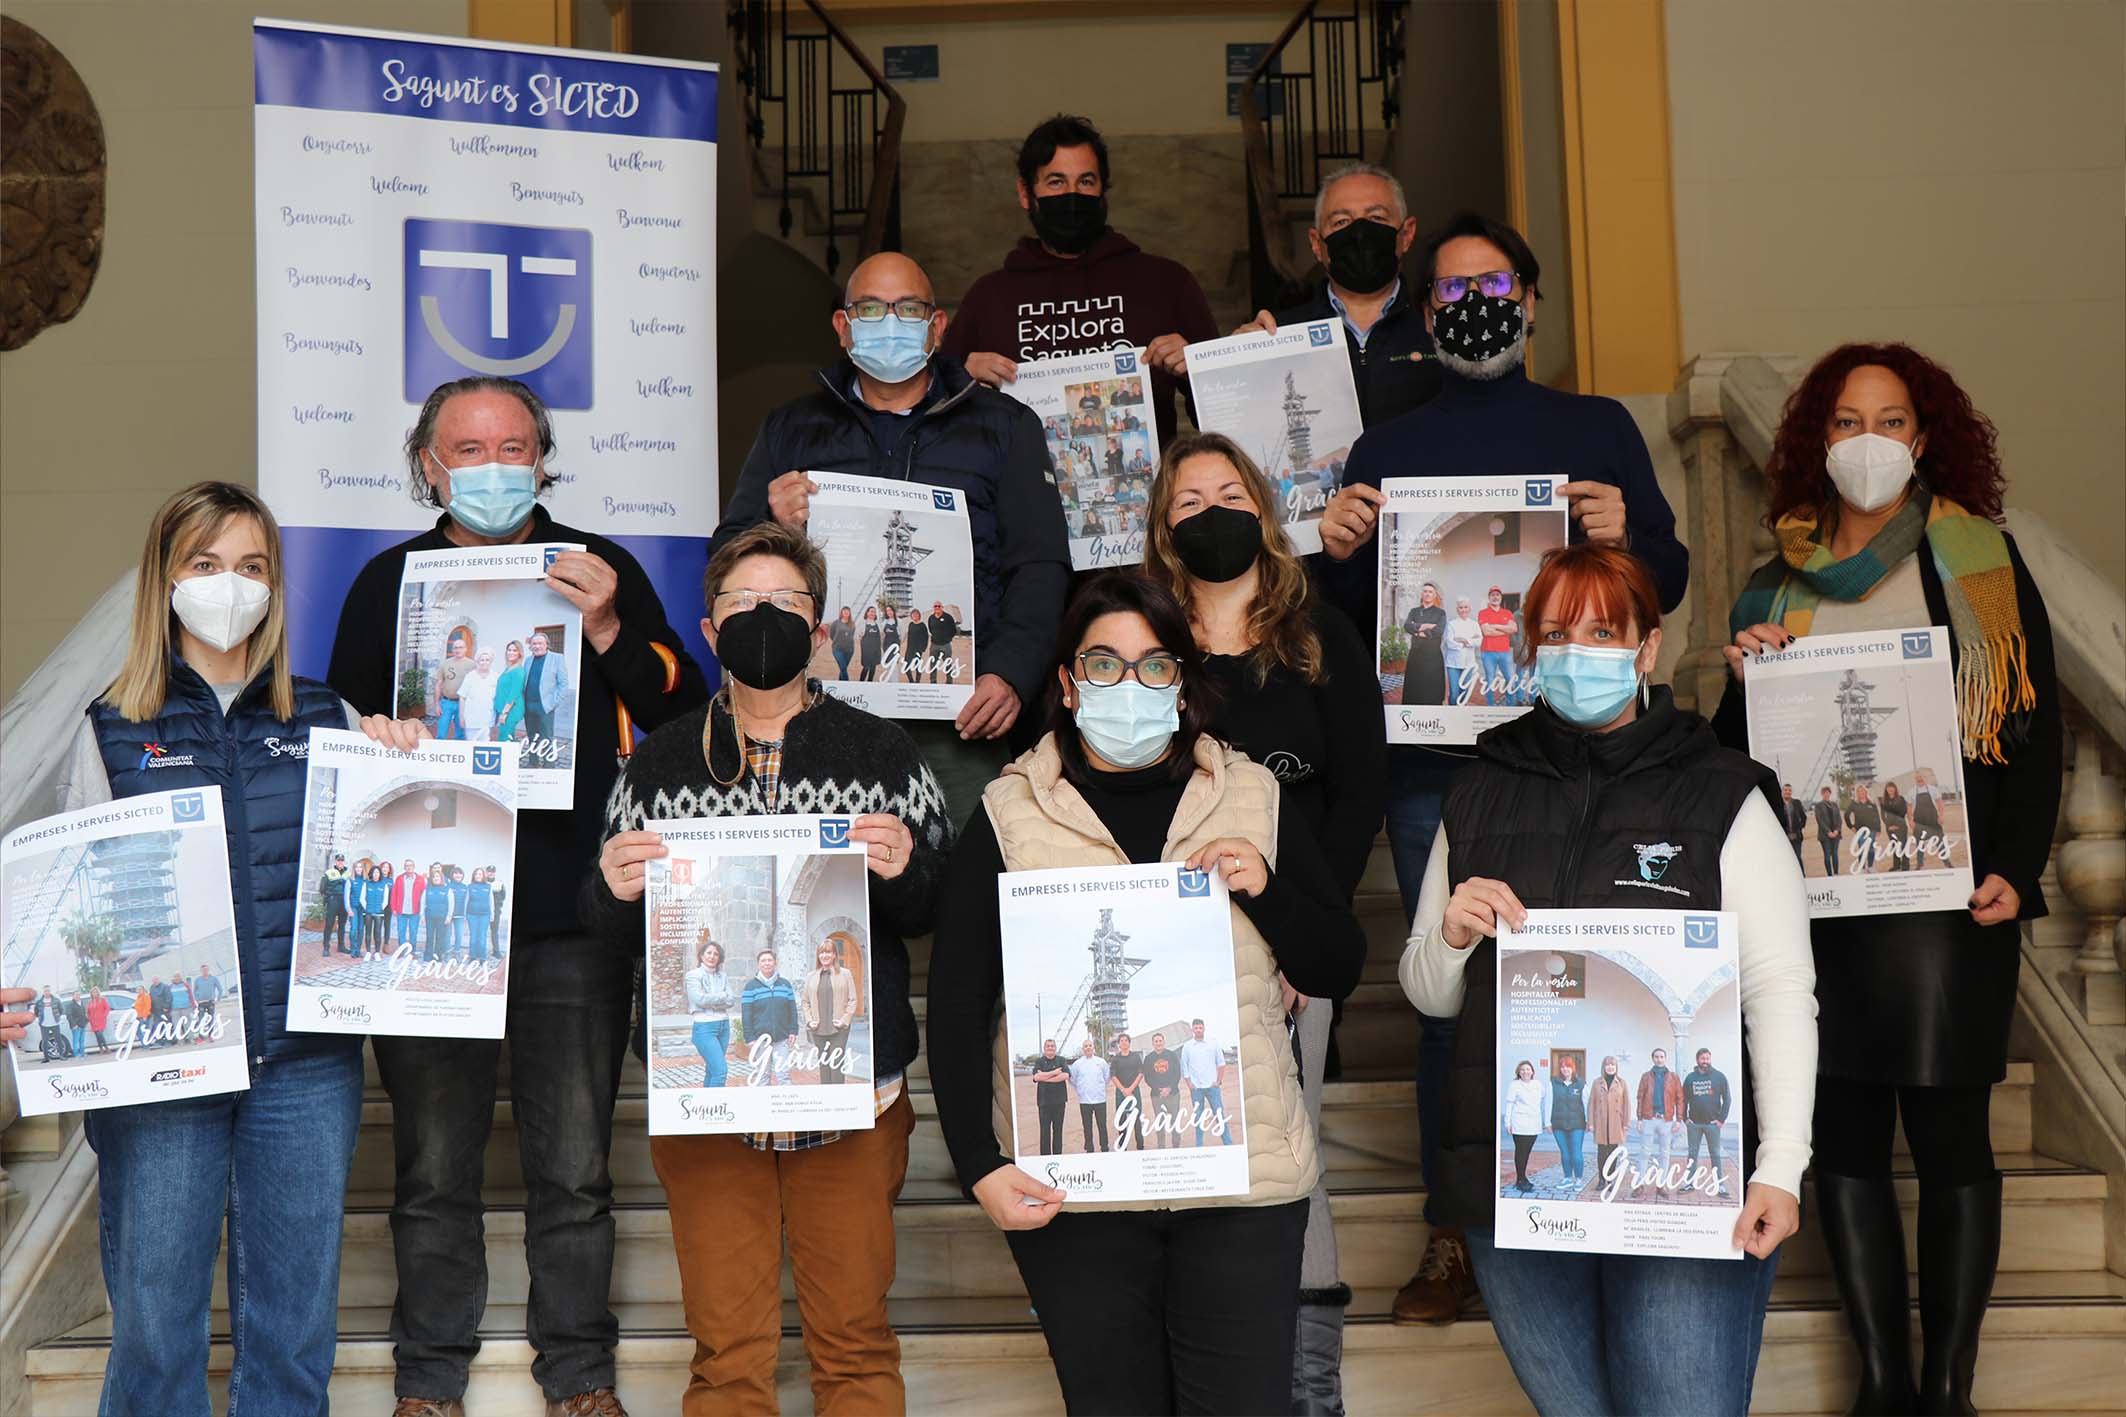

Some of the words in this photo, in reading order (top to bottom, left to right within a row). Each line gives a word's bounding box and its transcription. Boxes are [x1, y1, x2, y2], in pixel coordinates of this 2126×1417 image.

[382, 59, 489, 108] Sagunt
[490, 83, 519, 112] es
[528, 73, 640, 119] SICTED
[448, 135, 538, 159] Willkommen
[607, 151, 665, 172] Welkom
[370, 175, 430, 195] Welcome
[511, 181, 584, 206] Benvinguts
[280, 206, 353, 226] Benvenuti
[616, 208, 682, 229] Bienvenue
[286, 267, 372, 290] Bienvenidos
[630, 318, 686, 336] Welcome
[1018, 316, 1125, 346] Explora
[284, 332, 363, 356] Benvinguts
[1194, 346, 1237, 361] EMPRESES
[1243, 340, 1275, 352] SERVEIS
[1275, 334, 1304, 346] SICTED
[1015, 370, 1046, 381] PRESES
[1052, 365, 1082, 377] SERVEIS
[1083, 361, 1110, 371] SICTED
[636, 379, 694, 399] Welkom
[292, 404, 354, 424] Welcome
[589, 433, 676, 453] Willkommen
[319, 468, 401, 491] Bienvenidos
[867, 487, 900, 498] SERVEIS
[901, 491, 929, 501] SICTED
[1287, 484, 1339, 524] Gràc
[1390, 489, 1438, 499] EMPRESES
[1445, 488, 1483, 498] SERVEIS
[1485, 488, 1519, 497] SICTED
[603, 495, 676, 517] Benvinguts
[1090, 528, 1145, 567] Gràcie
[414, 559, 460, 570] EMPRESES
[467, 557, 504, 567] SERVEIS
[505, 556, 538, 565] SICTED
[879, 643, 967, 684] Gràcies
[1754, 650, 1806, 665] EMPRESES
[1813, 646, 1855, 657] SERVEIS
[1857, 642, 1895, 654] SICTED
[1456, 663, 1542, 706] Gràcie
[149, 755, 193, 763] COMUNITAT
[267, 740, 309, 757] Sagu
[321, 742, 377, 758] EMPRESES
[384, 750, 427, 762] SERVEIS
[429, 752, 466, 764] SICTED
[508, 733, 566, 762] cies
[148, 761, 194, 769] VALENCIANA
[12, 825, 68, 848] EMPRESES
[77, 812, 122, 830] SERVEIS
[123, 805, 164, 821] SICTED
[659, 830, 716, 841] EMPRESES
[725, 829, 770, 840] SERVEIS
[773, 828, 812, 839] SICTED
[1850, 826, 1960, 874] Gràcies
[1011, 883, 1070, 897] EMPRESES
[1079, 881, 1126, 893] SERVEIS
[1129, 878, 1170, 890] SICTED
[1582, 924, 1629, 935] SERVEIS
[1632, 925, 1676, 936] SICTED
[386, 942, 498, 991] Gràcies
[1511, 973, 1528, 987] Per
[1530, 972, 1544, 988] la
[1545, 973, 1578, 988] vostra
[320, 998, 371, 1023] Sagunt
[115, 1007, 232, 1062] Gràcies
[747, 1033, 862, 1087] Gràcies
[156, 1071, 179, 1081] RADIO
[181, 1065, 207, 1078] taxi
[51, 1078, 109, 1098] Sagunt
[681, 1098, 735, 1121] Sagunt
[1113, 1095, 1233, 1152] Gràcies
[1047, 1166, 1103, 1190] Sagunt
[1600, 1146, 1730, 1203] Gràcies
[1529, 1210, 1587, 1239] Sagunt
